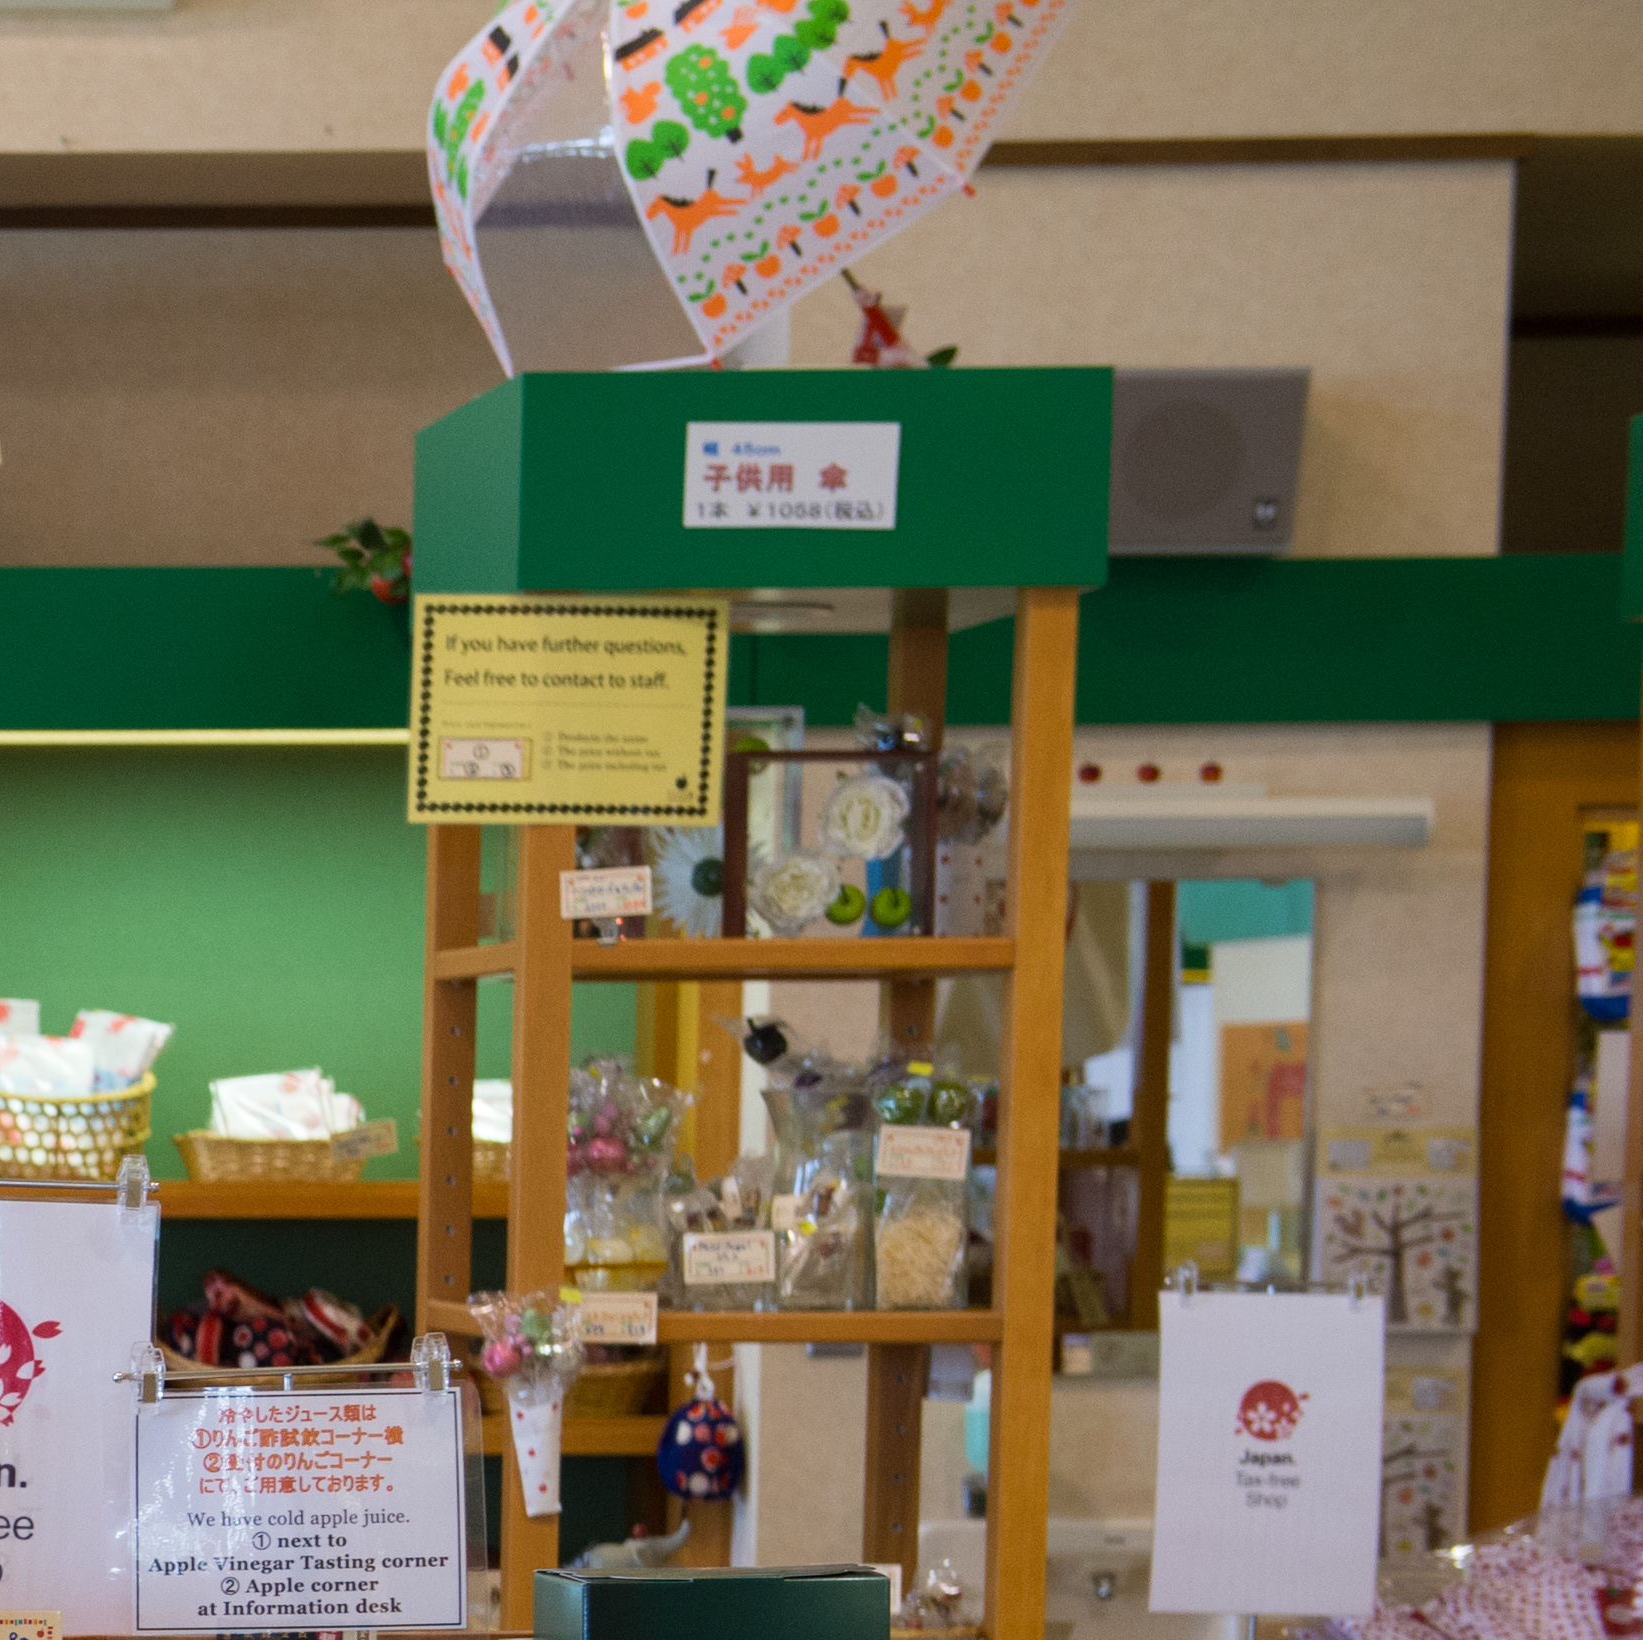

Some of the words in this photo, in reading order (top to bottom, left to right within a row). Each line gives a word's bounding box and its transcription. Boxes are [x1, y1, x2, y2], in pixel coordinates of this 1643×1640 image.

[702, 462, 795, 493] 子供用
[818, 462, 848, 492] 傘
[446, 634, 459, 653] If
[462, 638, 492, 658] you
[496, 635, 536, 654] have
[540, 635, 600, 655] further
[604, 637, 687, 658] questions,
[444, 669, 480, 688] Feel
[482, 669, 516, 688] free
[520, 672, 538, 689] to
[541, 671, 605, 690] contact
[608, 672, 626, 689] to
[629, 670, 670, 690] staff.
[1239, 1450, 1298, 1468] Japan.
[187, 1512, 216, 1528] We
[221, 1511, 262, 1527] have
[268, 1510, 305, 1526] cold
[310, 1511, 359, 1529] apple
[362, 1510, 410, 1528] juice.
[277, 1534, 322, 1548] next
[327, 1533, 348, 1548] to
[148, 1557, 208, 1575] Apple
[215, 1556, 295, 1573] Vinegar
[301, 1555, 376, 1573] Tasting
[381, 1555, 449, 1569] corner
[246, 1579, 305, 1597] Apple
[311, 1579, 379, 1593] corner
[197, 1603, 217, 1616] at
[224, 1600, 349, 1616] Information
[356, 1598, 402, 1614] desk
